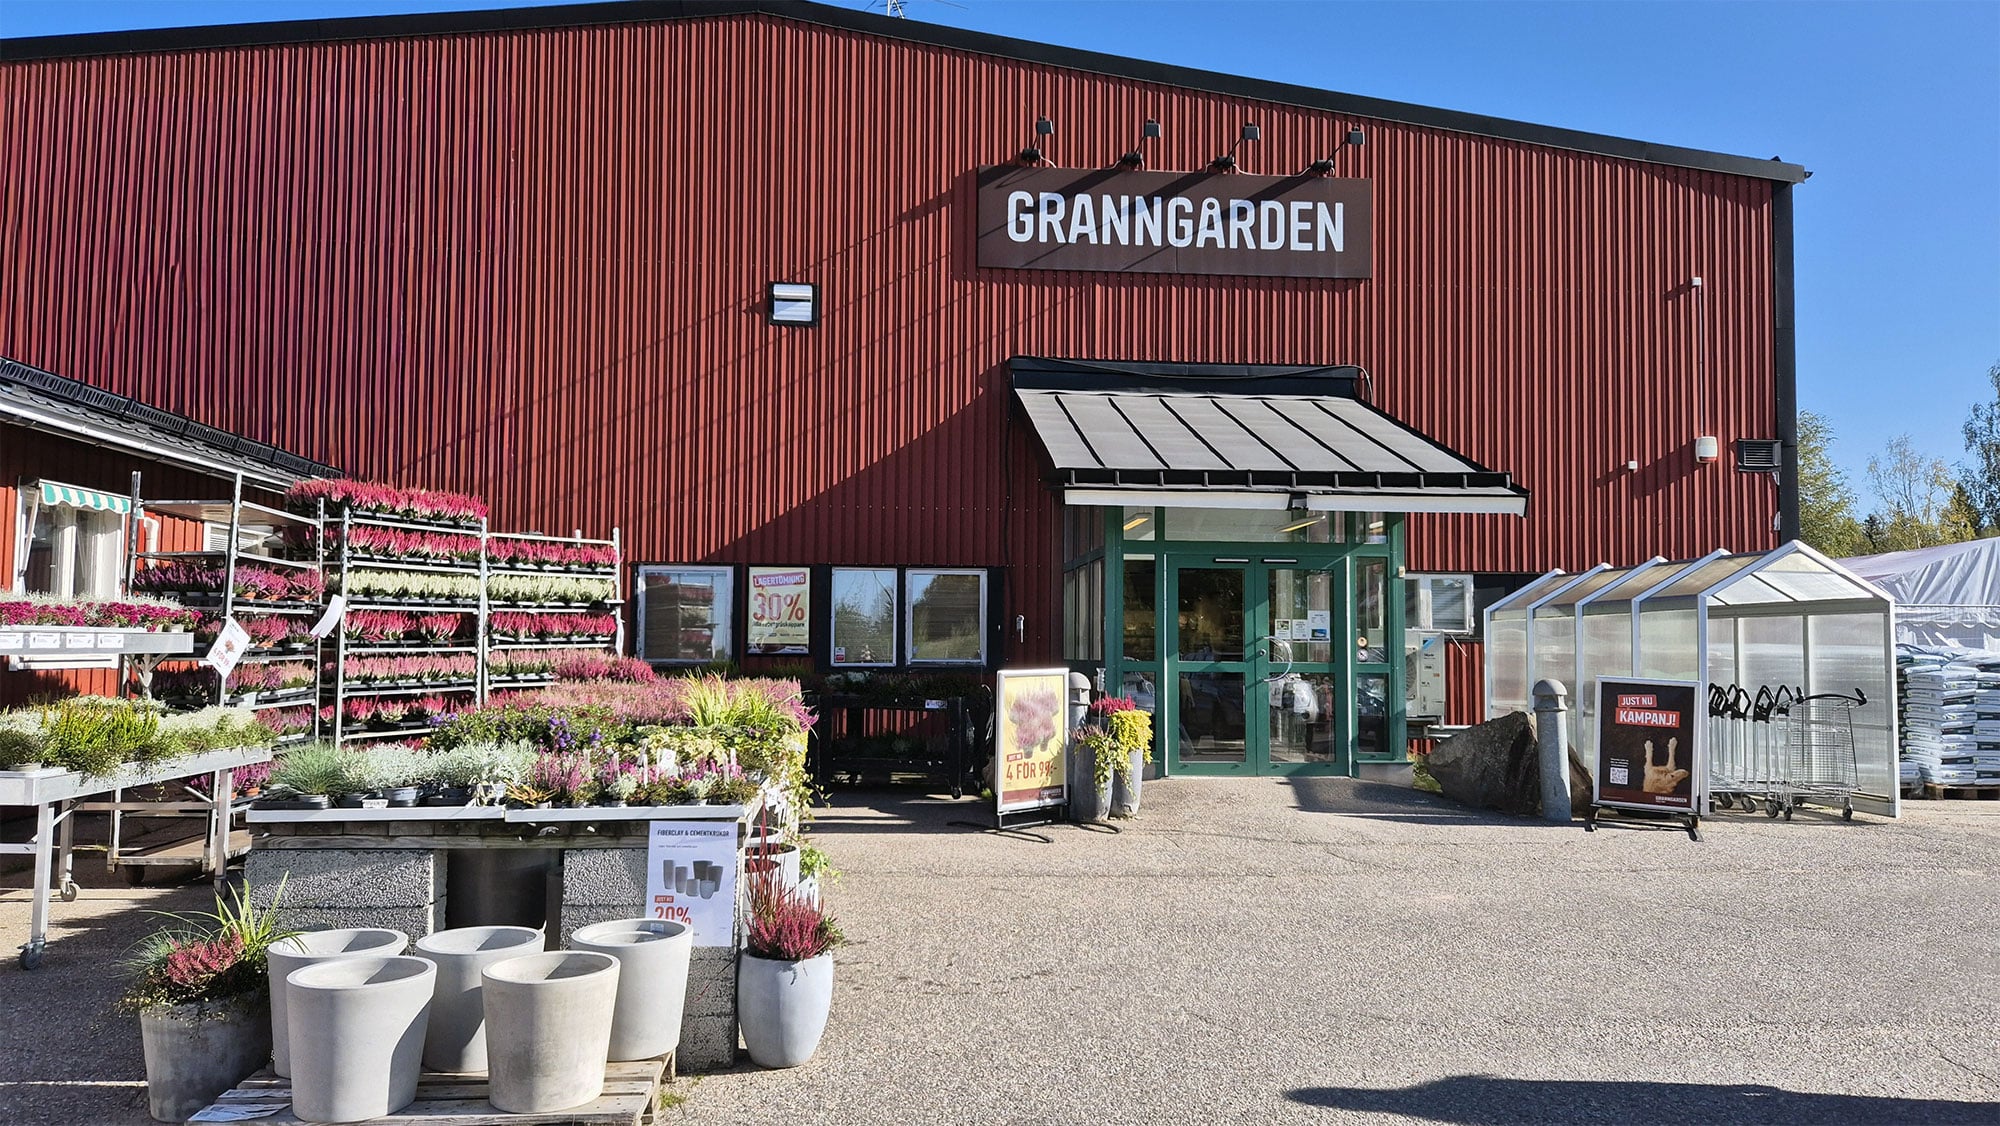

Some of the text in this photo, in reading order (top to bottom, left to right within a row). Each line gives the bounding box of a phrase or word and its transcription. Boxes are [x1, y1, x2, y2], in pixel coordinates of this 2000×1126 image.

[1007, 190, 1344, 252] GRANNGÅRDEN
[754, 575, 805, 586] LAGERTÖMNING
[753, 592, 805, 621] 30%
[1621, 697, 1653, 706] JUST NU
[1620, 710, 1677, 726] KAMPANJ!
[1006, 764, 1013, 780] 4
[1016, 761, 1036, 779] FÖR
[657, 829, 684, 837] FIBERCLAY
